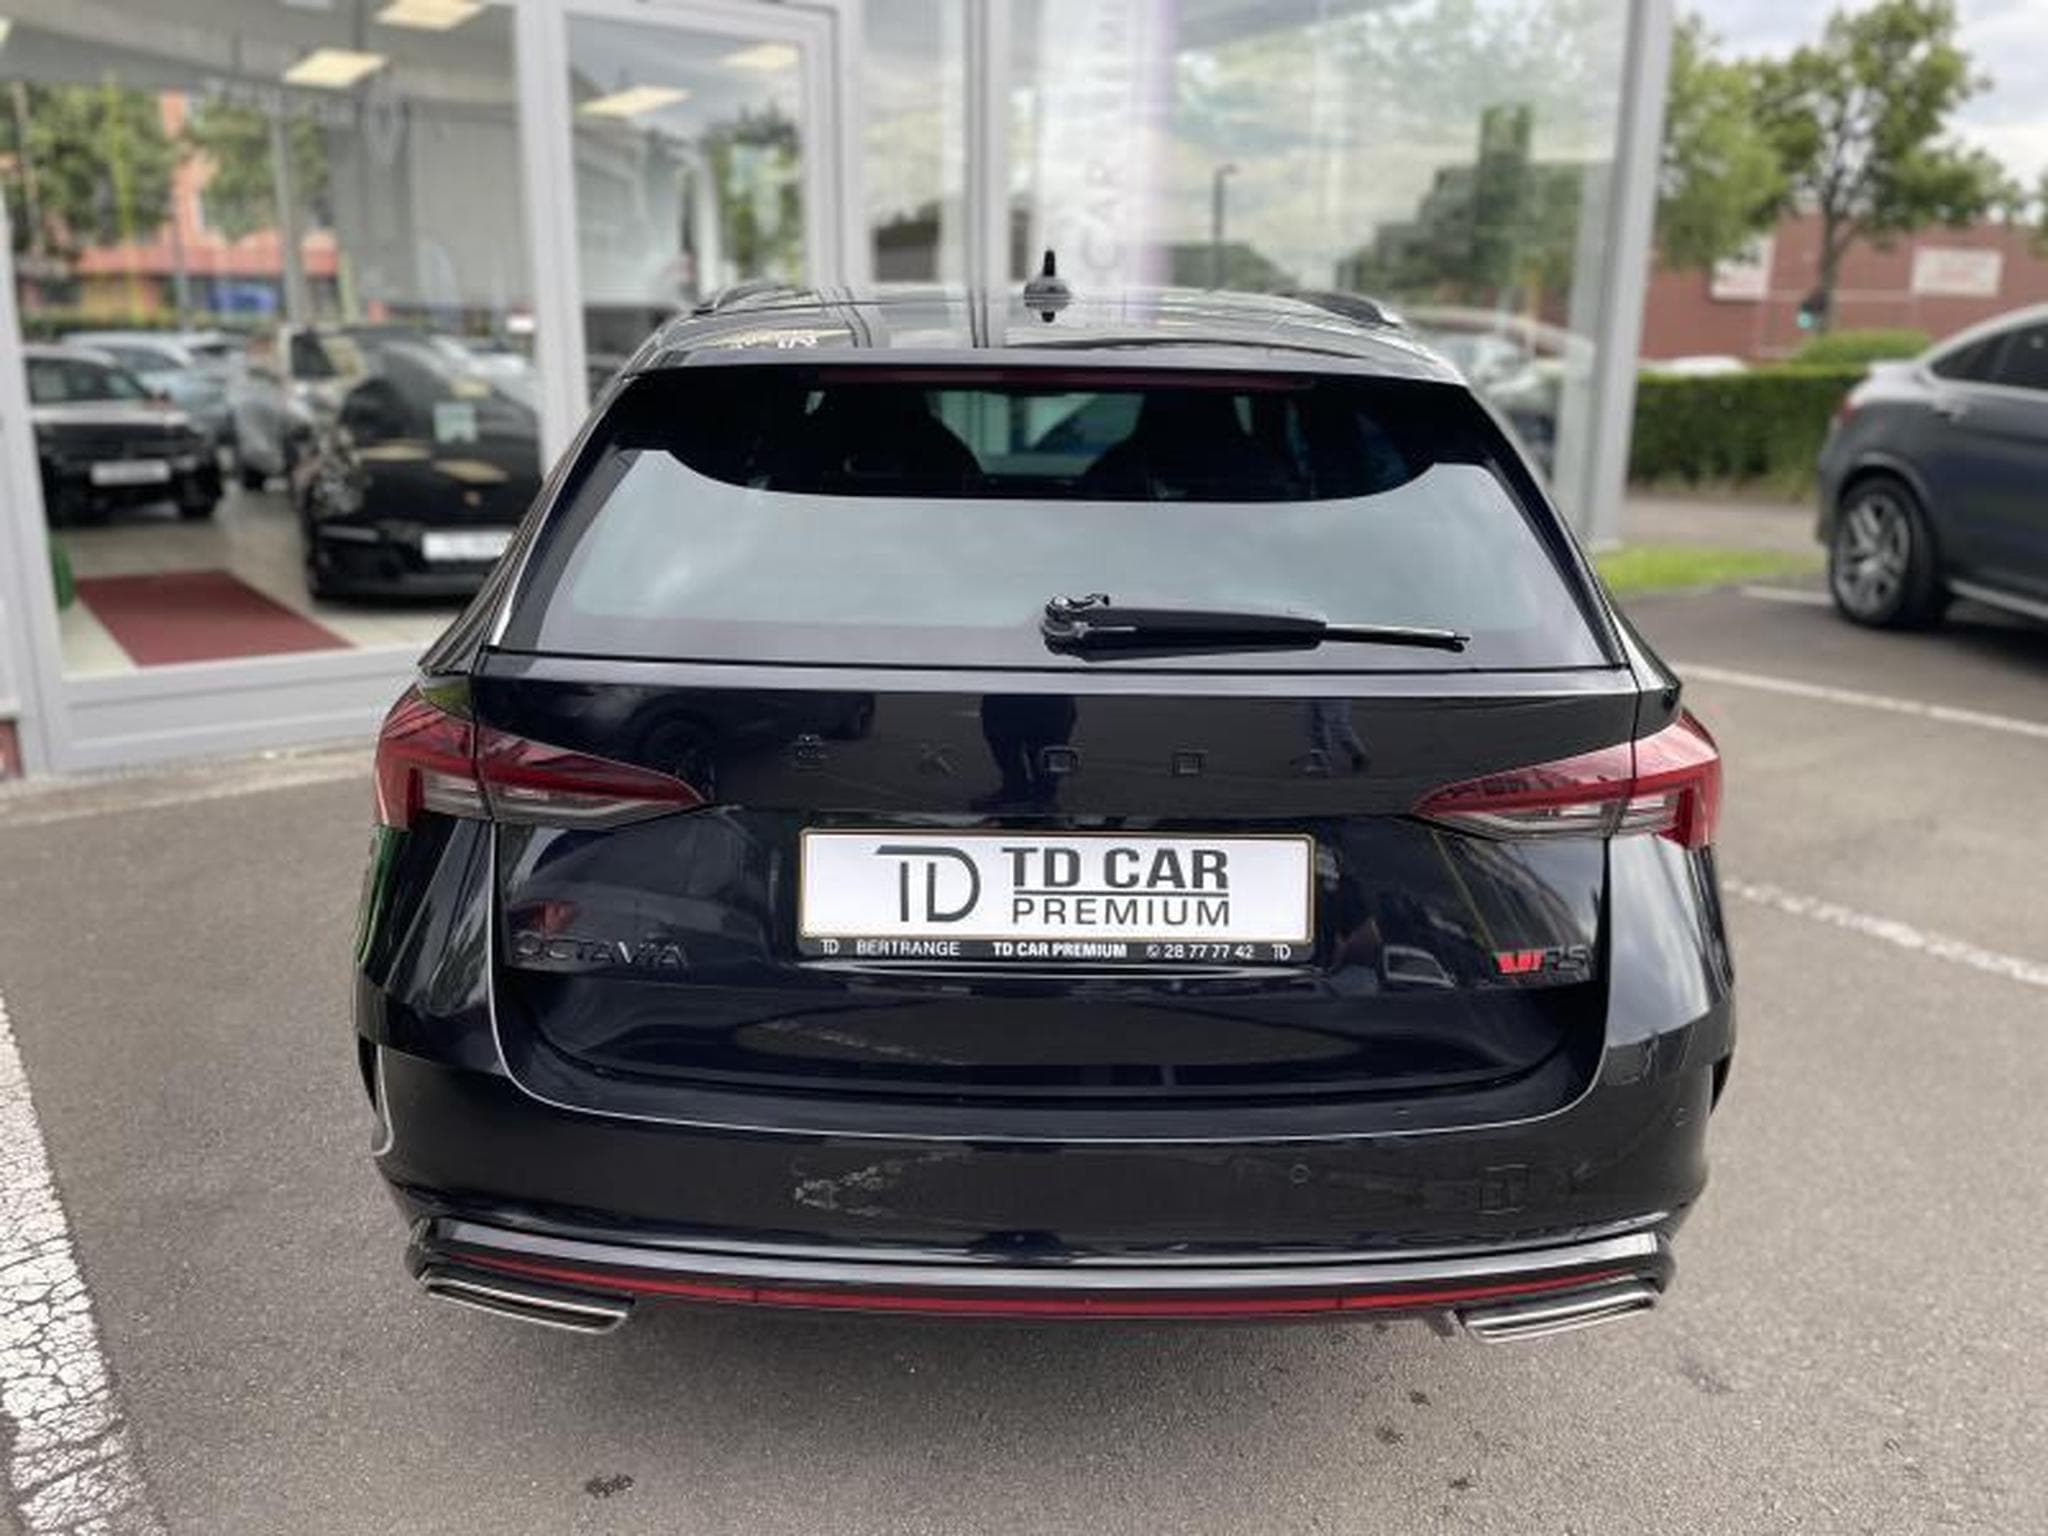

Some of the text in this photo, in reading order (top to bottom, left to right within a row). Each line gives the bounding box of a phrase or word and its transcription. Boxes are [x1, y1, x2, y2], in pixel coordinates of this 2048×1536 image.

[1002, 847, 1230, 889] TD CAR
[1012, 898, 1230, 926] PREMIUM
[820, 938, 961, 957] TD BERTRANGE
[992, 941, 1128, 958] TD CAR PREMIUM
[1164, 944, 1255, 959] 28 77 77 42
[1271, 944, 1291, 961] TD
